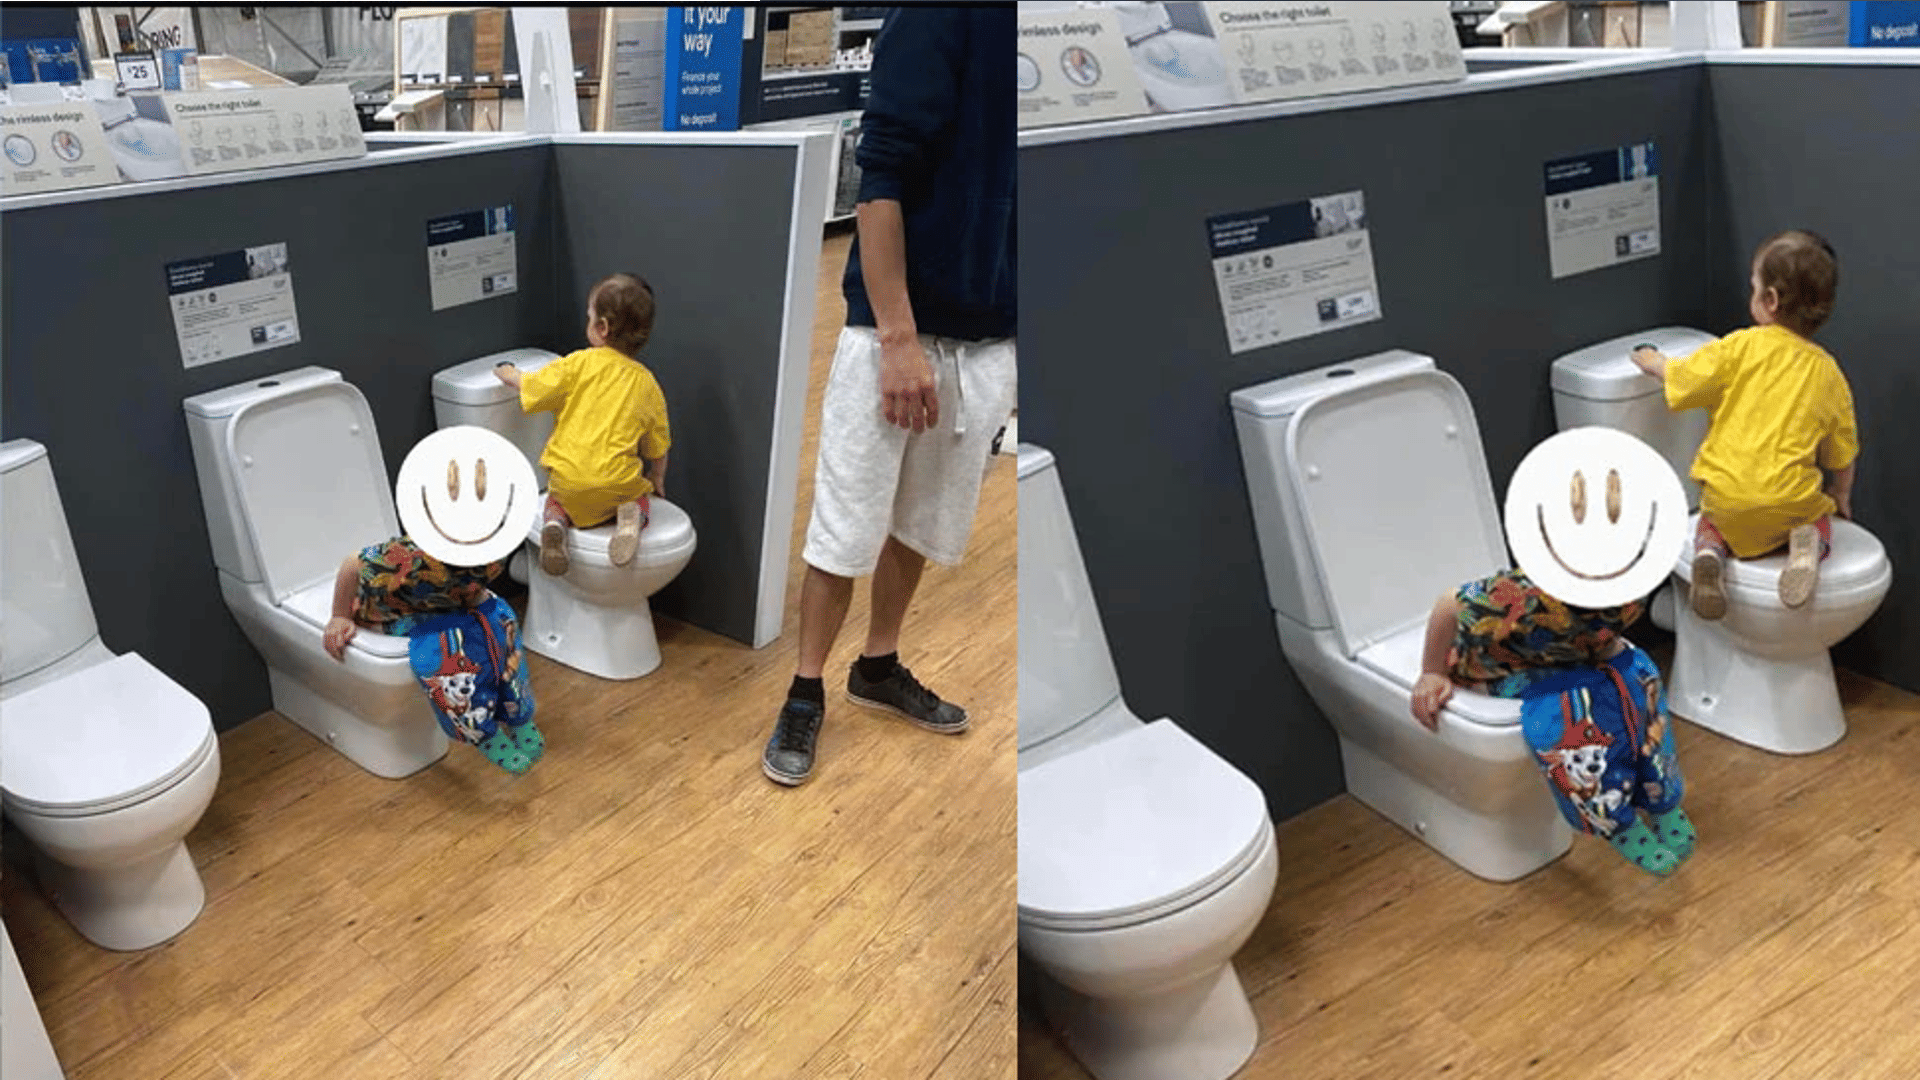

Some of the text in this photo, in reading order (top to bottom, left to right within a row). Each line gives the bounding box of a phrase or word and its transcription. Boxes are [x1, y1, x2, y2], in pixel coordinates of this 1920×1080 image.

[360, 7, 397, 21] FLO
[698, 7, 731, 31] your
[684, 33, 713, 58] way
